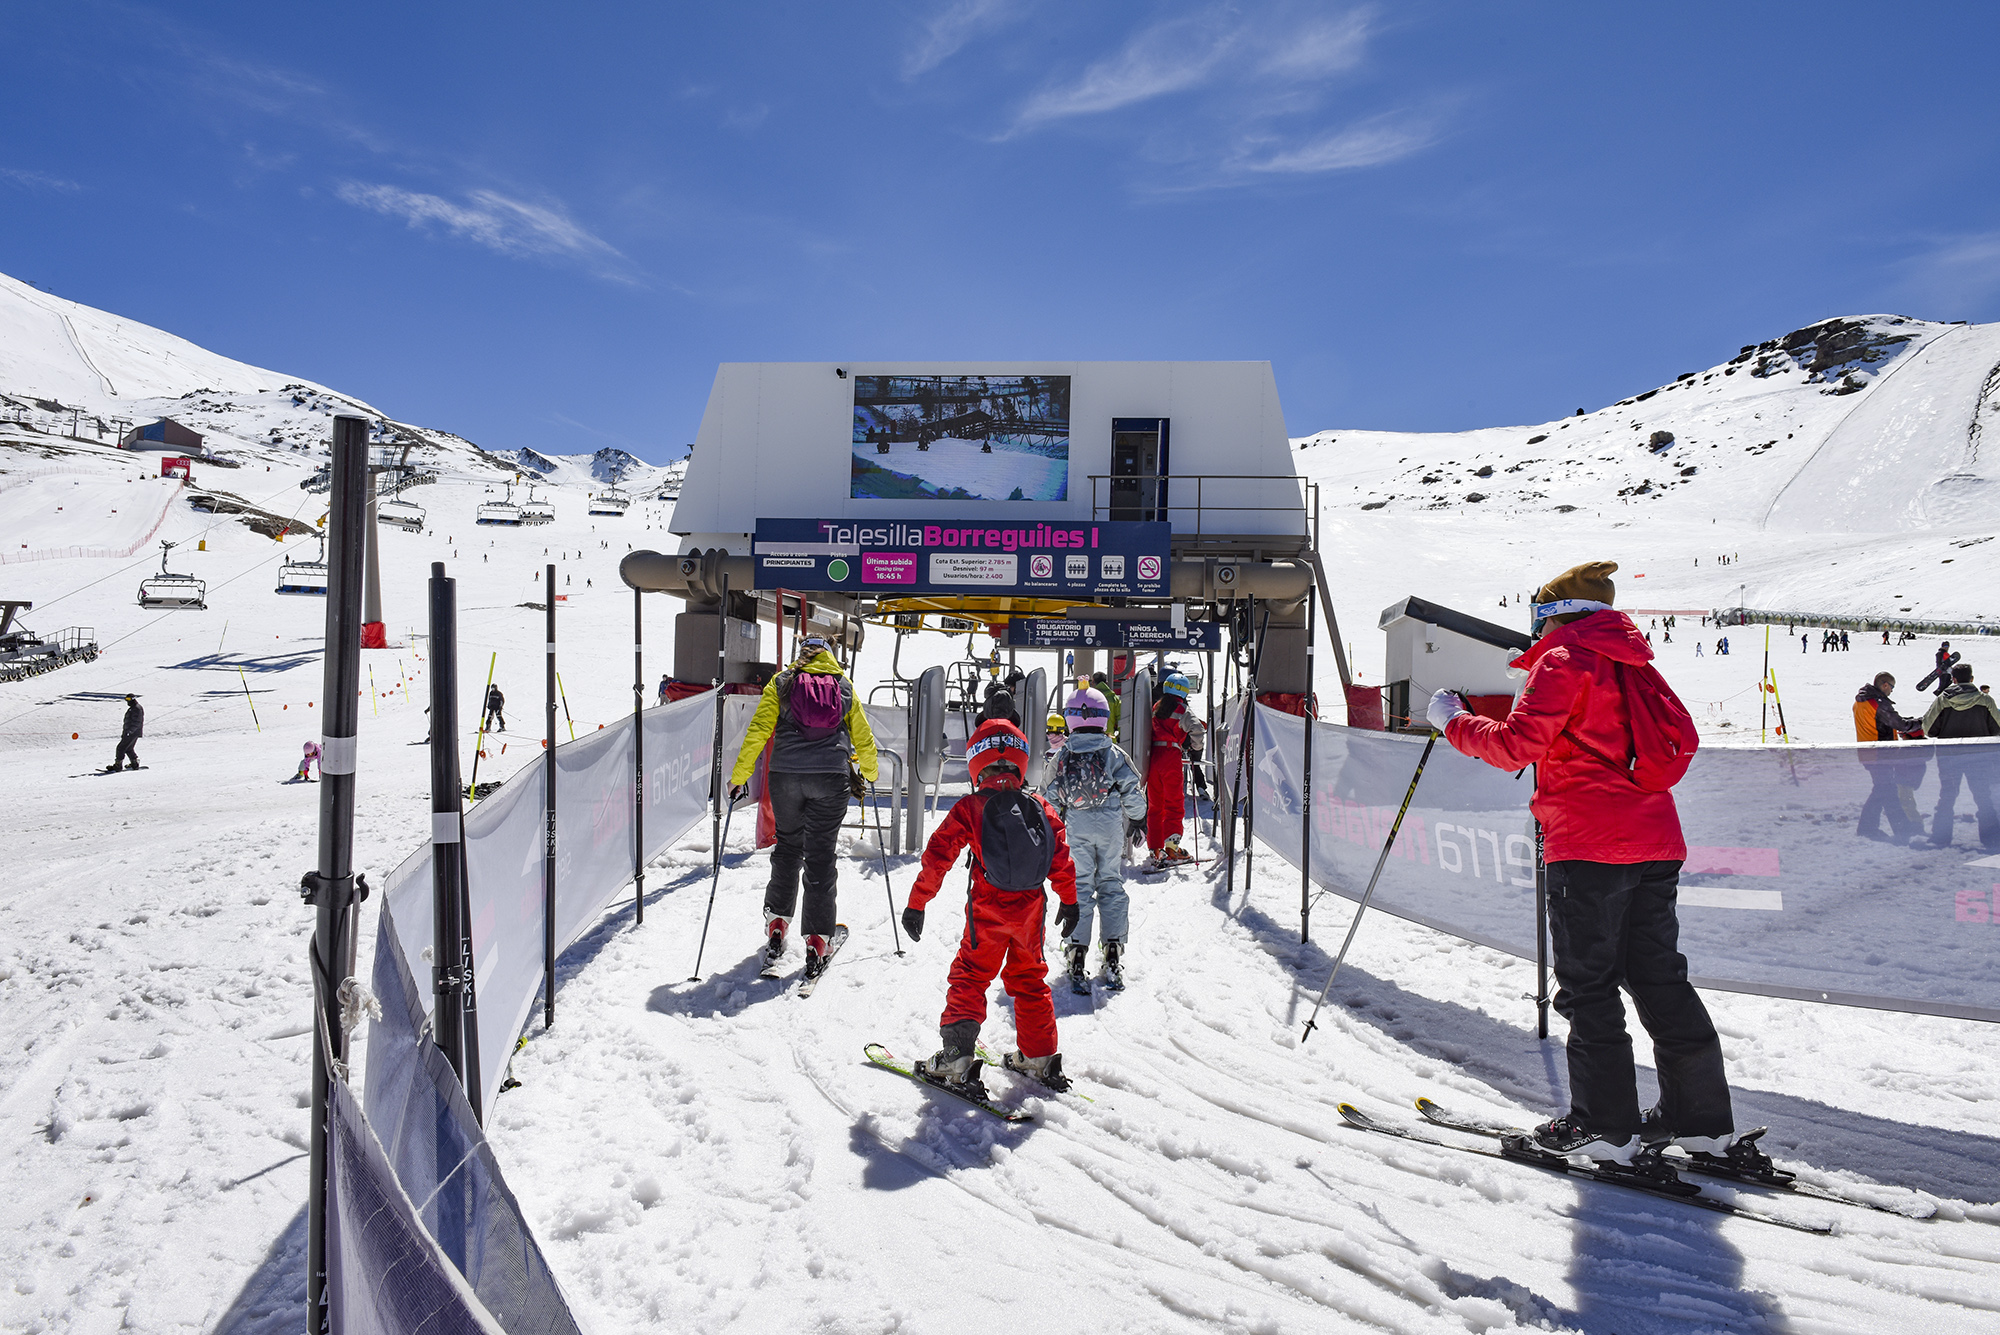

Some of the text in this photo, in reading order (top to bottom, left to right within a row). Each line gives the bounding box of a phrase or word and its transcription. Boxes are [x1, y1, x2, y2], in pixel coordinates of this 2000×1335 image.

[1091, 527, 1099, 548] I
[866, 556, 913, 566] Última subida
[876, 572, 895, 580] 16:45
[1129, 624, 1151, 632] NIÑOS
[462, 943, 474, 1007] LISKI
